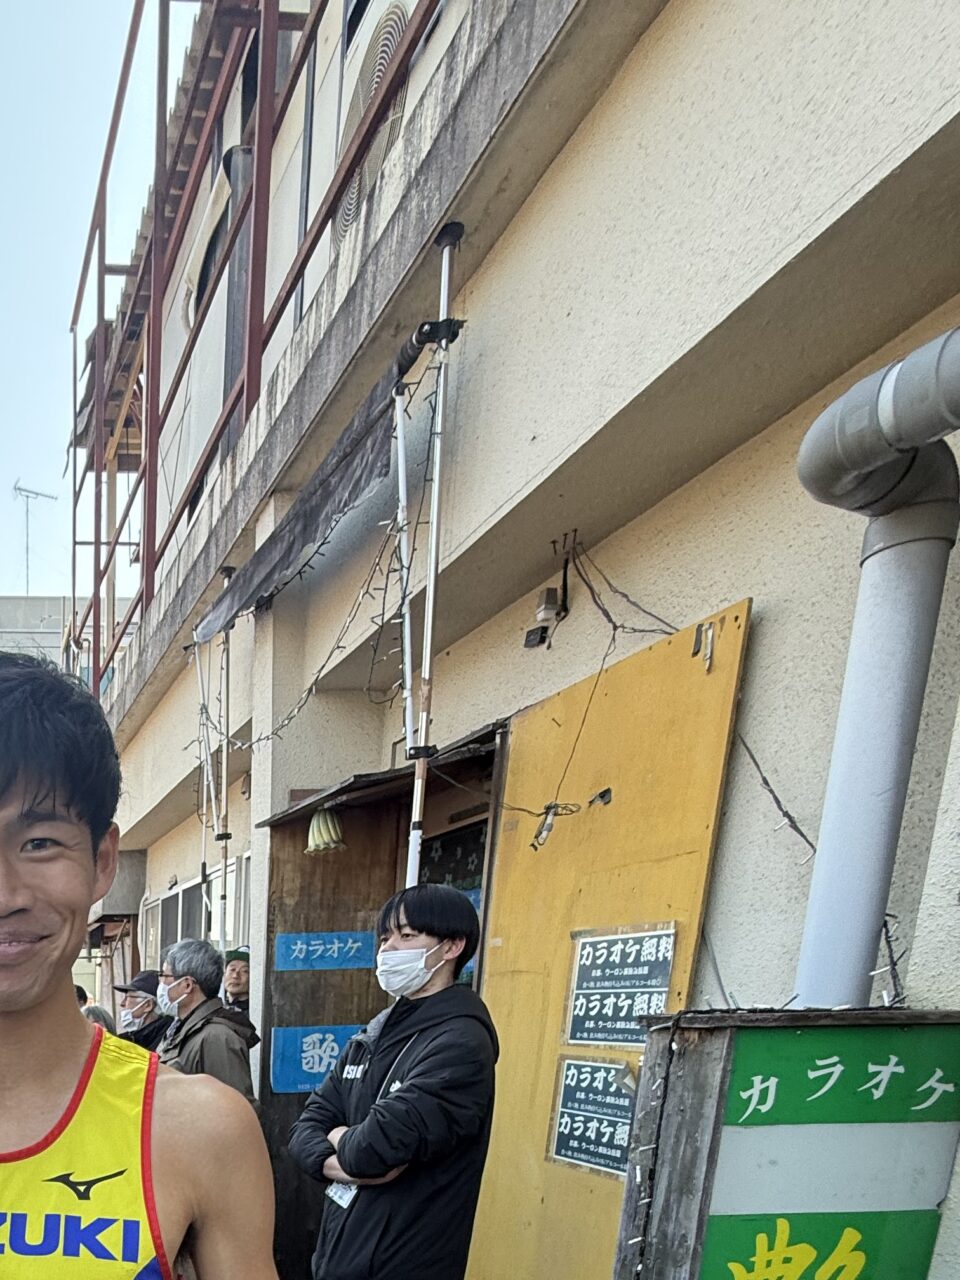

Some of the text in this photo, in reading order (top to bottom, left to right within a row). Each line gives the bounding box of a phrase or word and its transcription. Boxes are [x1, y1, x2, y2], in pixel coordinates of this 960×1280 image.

[290, 938, 362, 960] カラオケ
[580, 936, 673, 966] カラオケ無料
[574, 993, 666, 1016] カラオケ無料
[301, 1033, 339, 1073] 歌
[738, 1055, 955, 1124] カラオケ
